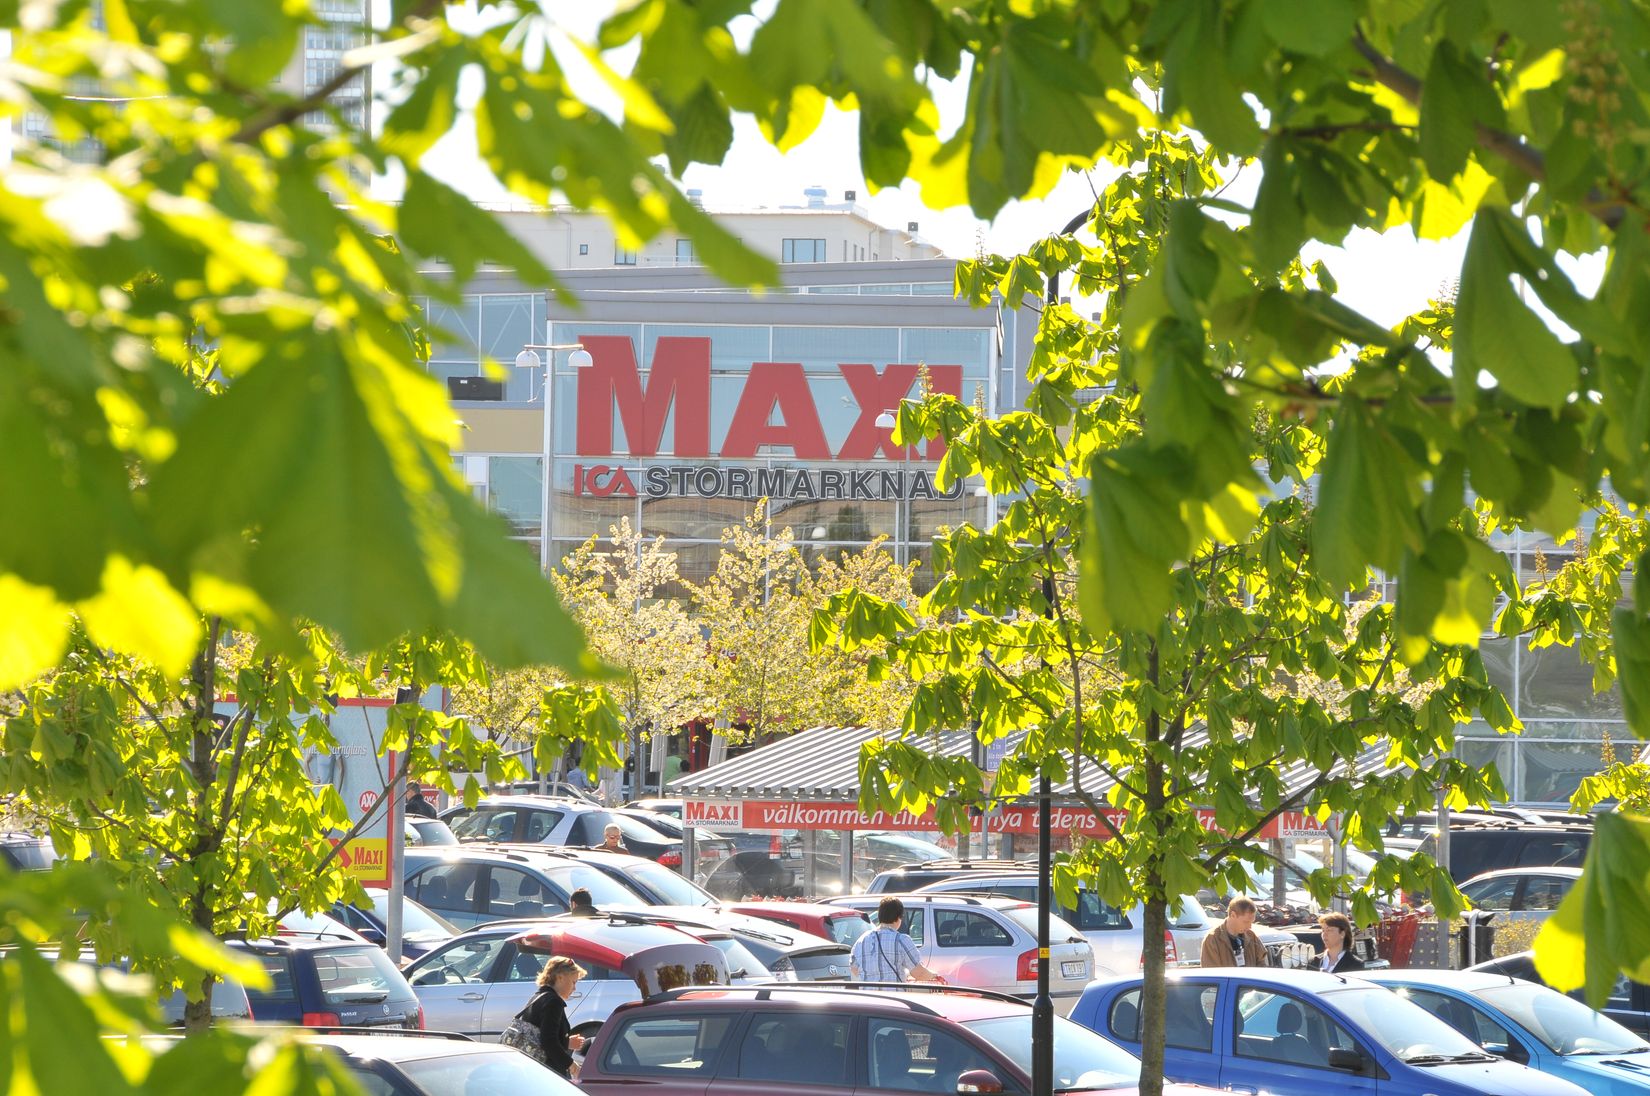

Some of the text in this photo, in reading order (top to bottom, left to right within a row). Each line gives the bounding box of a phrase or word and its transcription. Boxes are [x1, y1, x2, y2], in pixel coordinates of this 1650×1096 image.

[573, 464, 637, 498] ICA
[686, 802, 739, 820] MAXI
[763, 803, 884, 825] välkommen
[1032, 808, 1096, 829] tdens
[1283, 811, 1339, 831] MAI
[354, 847, 383, 865] MAXI
